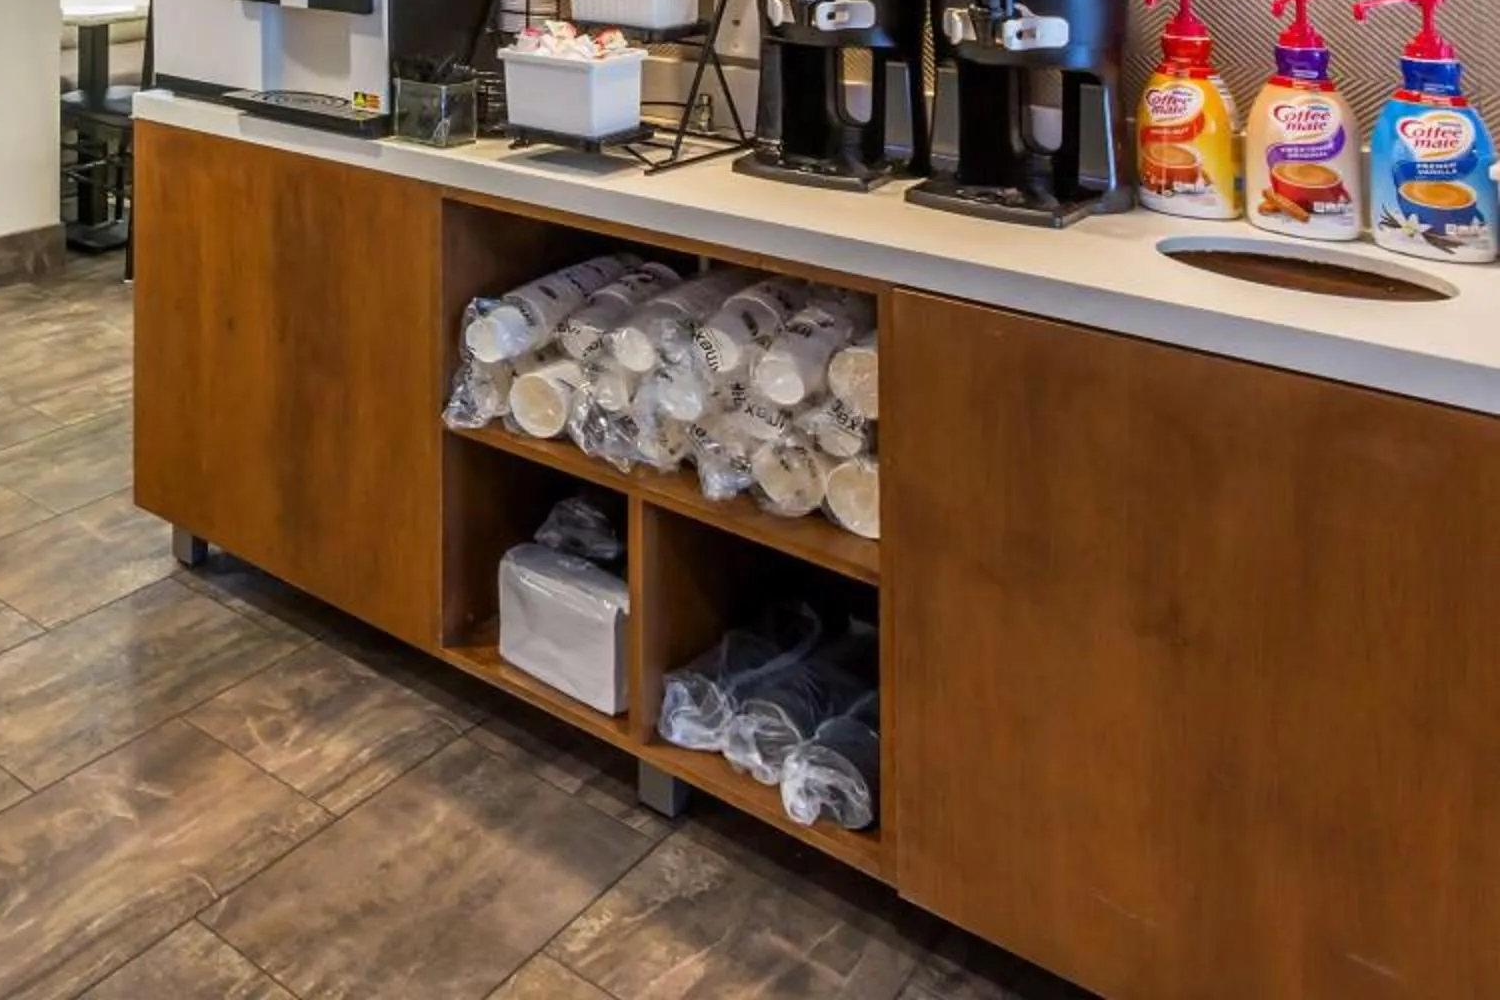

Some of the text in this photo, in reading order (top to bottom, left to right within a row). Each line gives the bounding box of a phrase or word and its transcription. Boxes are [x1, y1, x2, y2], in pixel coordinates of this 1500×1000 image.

[1273, 103, 1332, 122] Coffee
[1285, 119, 1327, 131] mate
[1400, 119, 1463, 138] Coffee
[1414, 135, 1459, 149] mate
